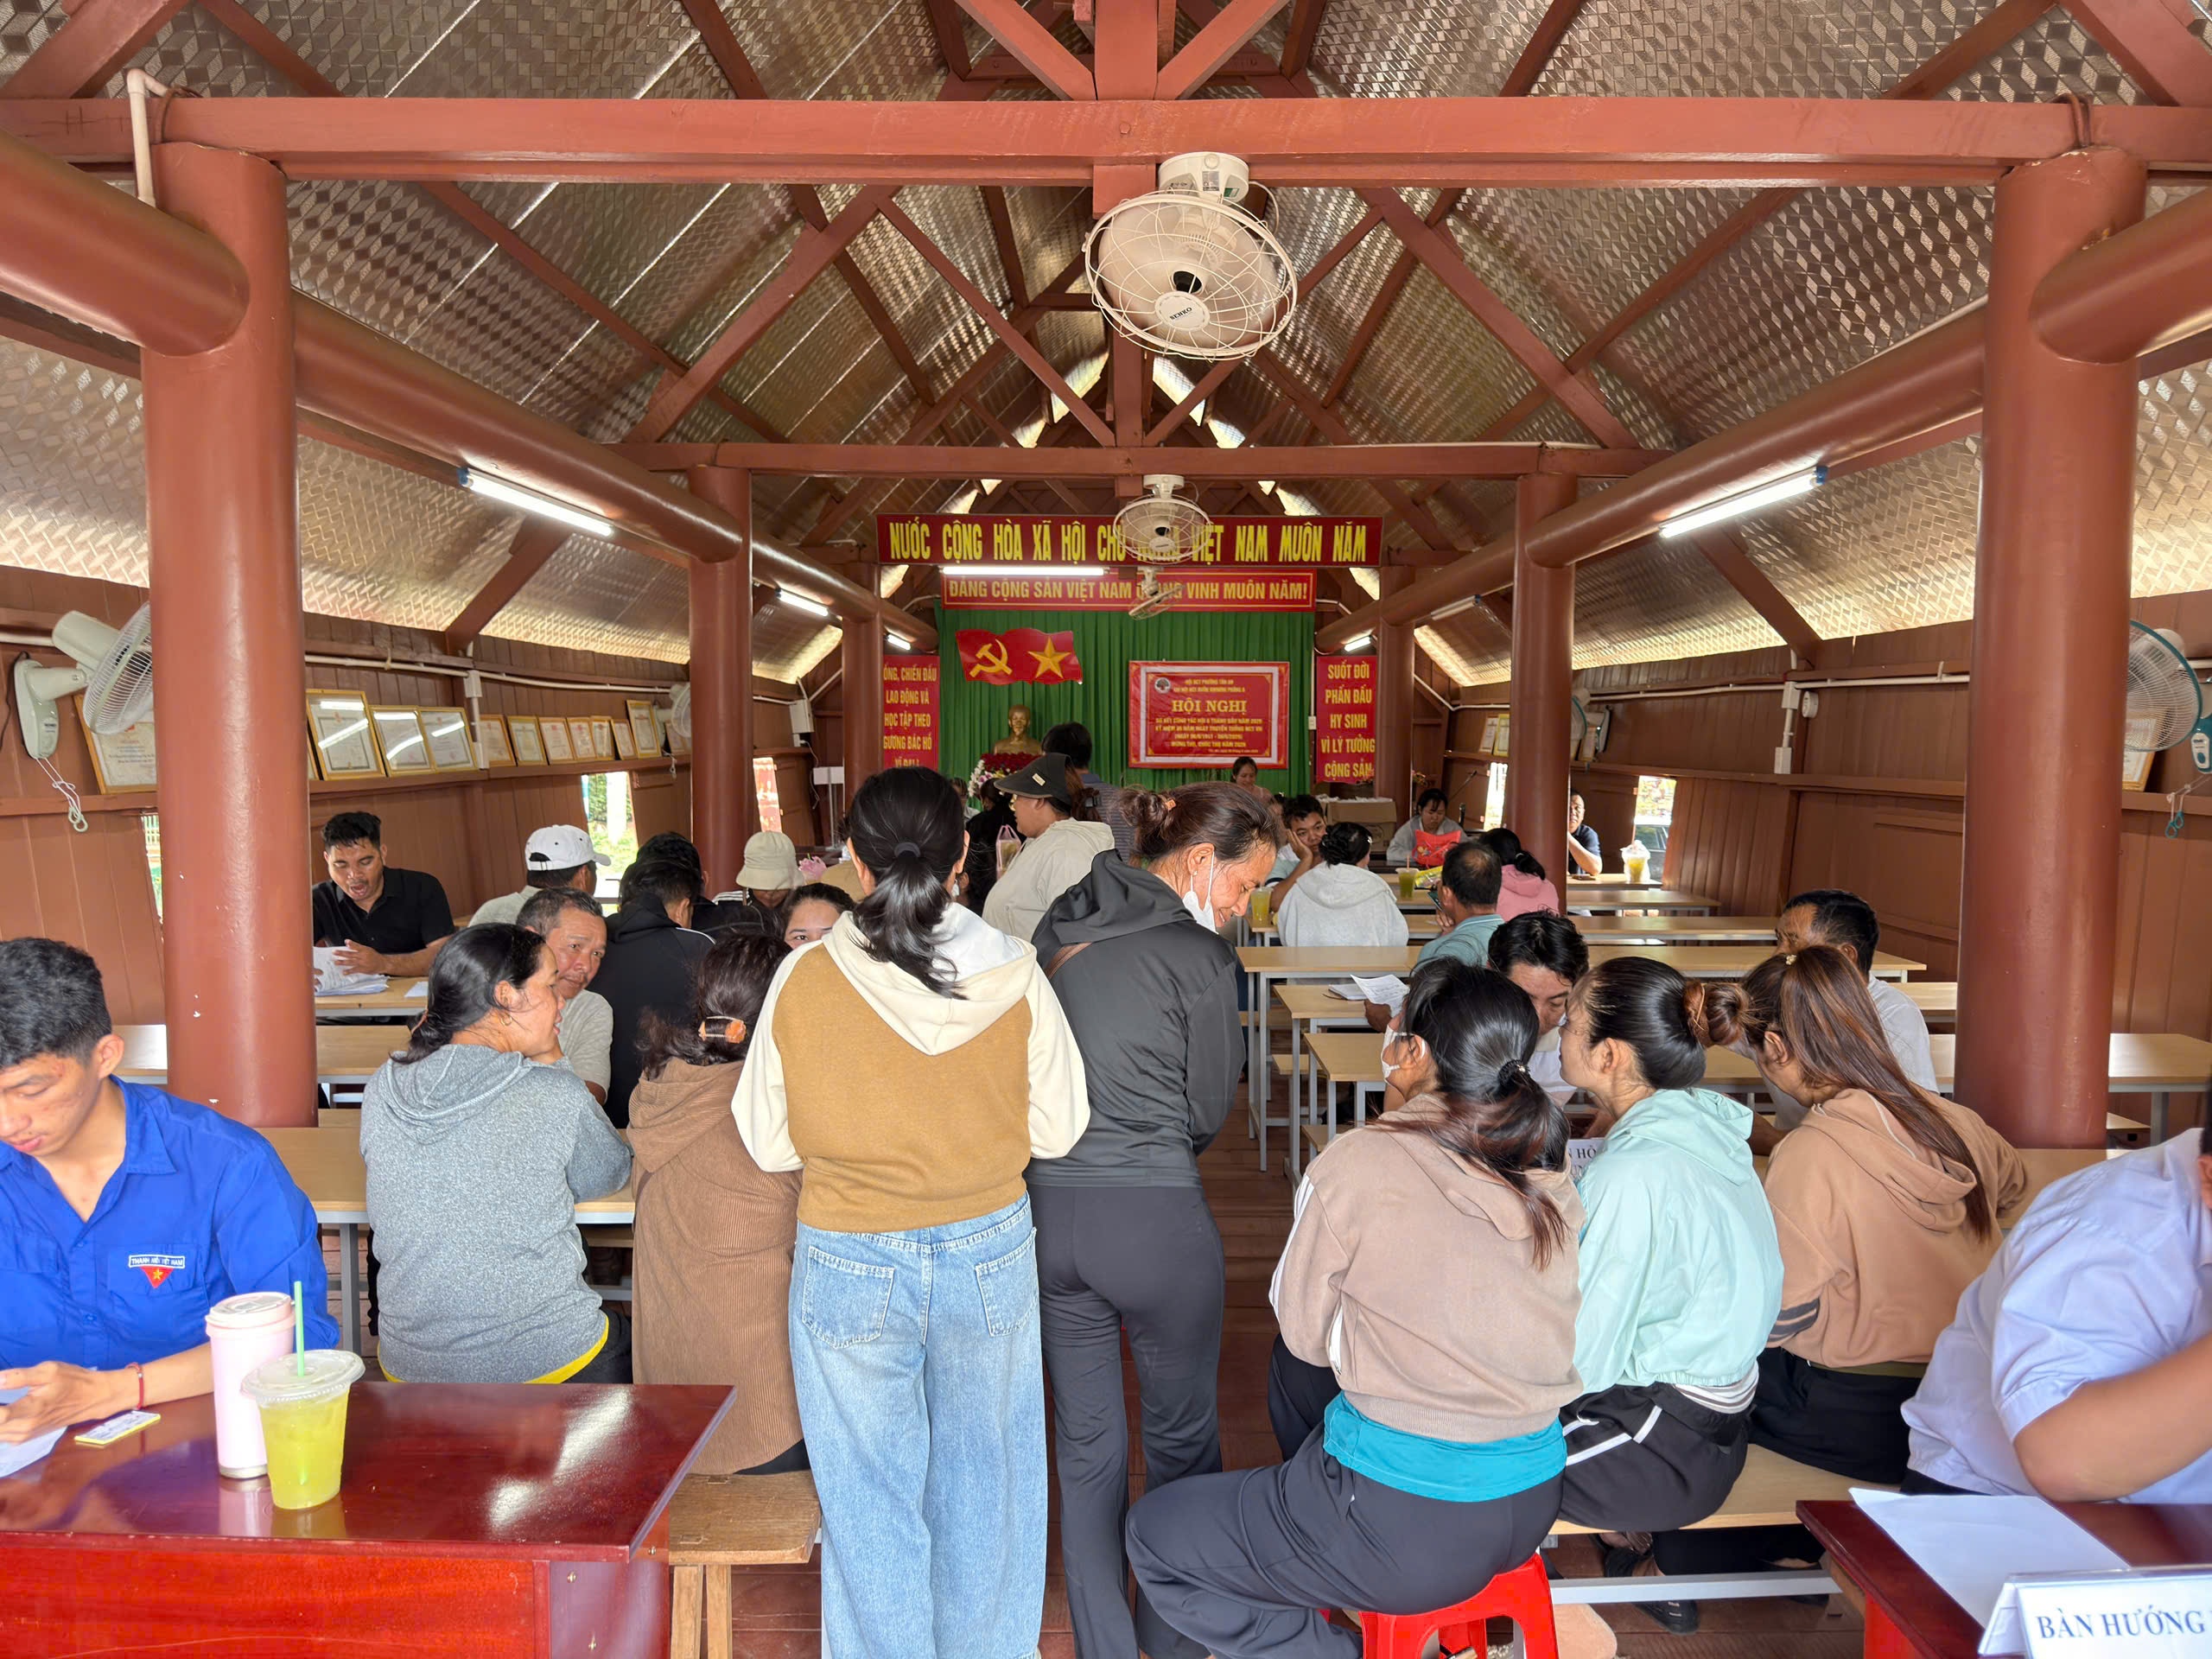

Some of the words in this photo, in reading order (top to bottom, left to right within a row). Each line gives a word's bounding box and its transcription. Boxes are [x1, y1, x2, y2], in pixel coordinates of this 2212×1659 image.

[1169, 307, 1192, 320] SENKO
[889, 517, 931, 559] NƯỚC
[942, 520, 982, 563] CỘNG
[994, 518, 1023, 560] HÒA
[1033, 520, 1052, 561] XÃ
[1061, 521, 1086, 564] HỘI
[1236, 524, 1268, 562] NAM
[1279, 521, 1323, 562] MUÔN
[1332, 521, 1366, 562] NĂM
[991, 578, 1029, 601] CỘNG
[1033, 575, 1063, 598] SẢN
[1066, 579, 1096, 601] VIỆT
[1099, 581, 1132, 599] NAM
[1186, 582, 1219, 600] VINH
[1224, 579, 1265, 600] MUÔN
[1268, 580, 1307, 600] NĂM!
[1327, 659, 1352, 678] SUỐT
[1353, 660, 1370, 678] ĐỜI
[886, 690, 899, 704] LAO
[900, 688, 919, 707] ĐỘNG
[1325, 684, 1351, 704] PHẤN
[1172, 697, 1202, 715] HỘI
[1205, 700, 1247, 715] NGHỊ
[884, 713, 898, 729] HỌC
[899, 710, 912, 729] TẬP
[914, 713, 931, 727] THEO
[1330, 714, 1342, 728] HY
[1344, 714, 1367, 728] SINH
[906, 733, 921, 750] BÁC
[1320, 736, 1330, 753] VÌ
[1332, 735, 1344, 753] LÝ
[1345, 734, 1376, 753] TƯỞNG
[1325, 760, 1351, 780] CỘNG
[2037, 1608, 2094, 1638] BÀN
[2101, 1605, 2206, 1637] HƯỚNG
